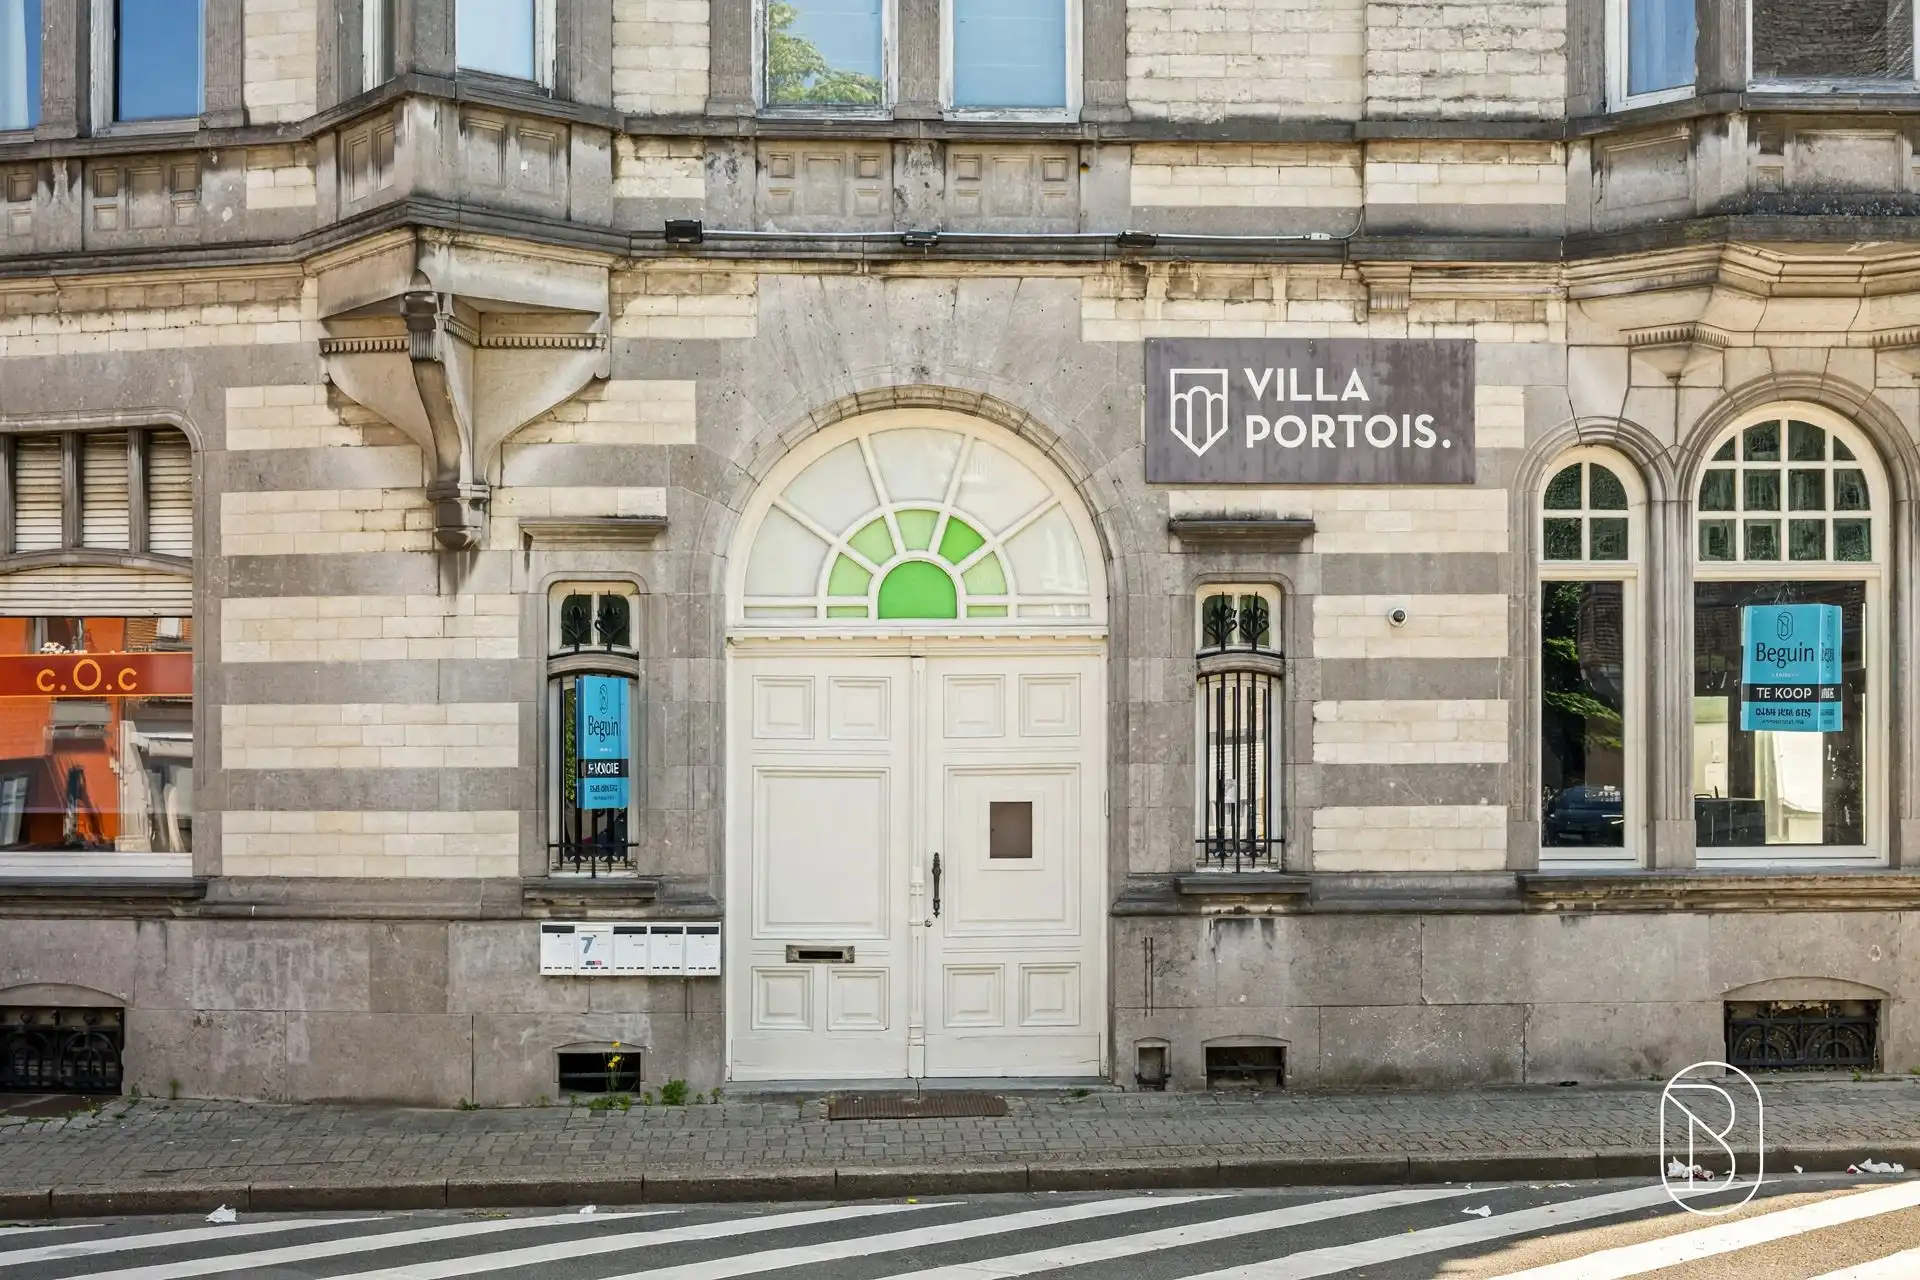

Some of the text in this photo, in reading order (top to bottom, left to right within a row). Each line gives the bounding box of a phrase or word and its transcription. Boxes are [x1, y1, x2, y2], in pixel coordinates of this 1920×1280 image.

[1243, 367, 1370, 402] VILLA
[1246, 414, 1451, 448] PORTOIS.
[1756, 642, 1814, 668] Beguin
[1756, 688, 1771, 699] TE
[1775, 688, 1812, 699] KOOP
[588, 715, 619, 742] Beguin
[581, 937, 593, 953] 7
